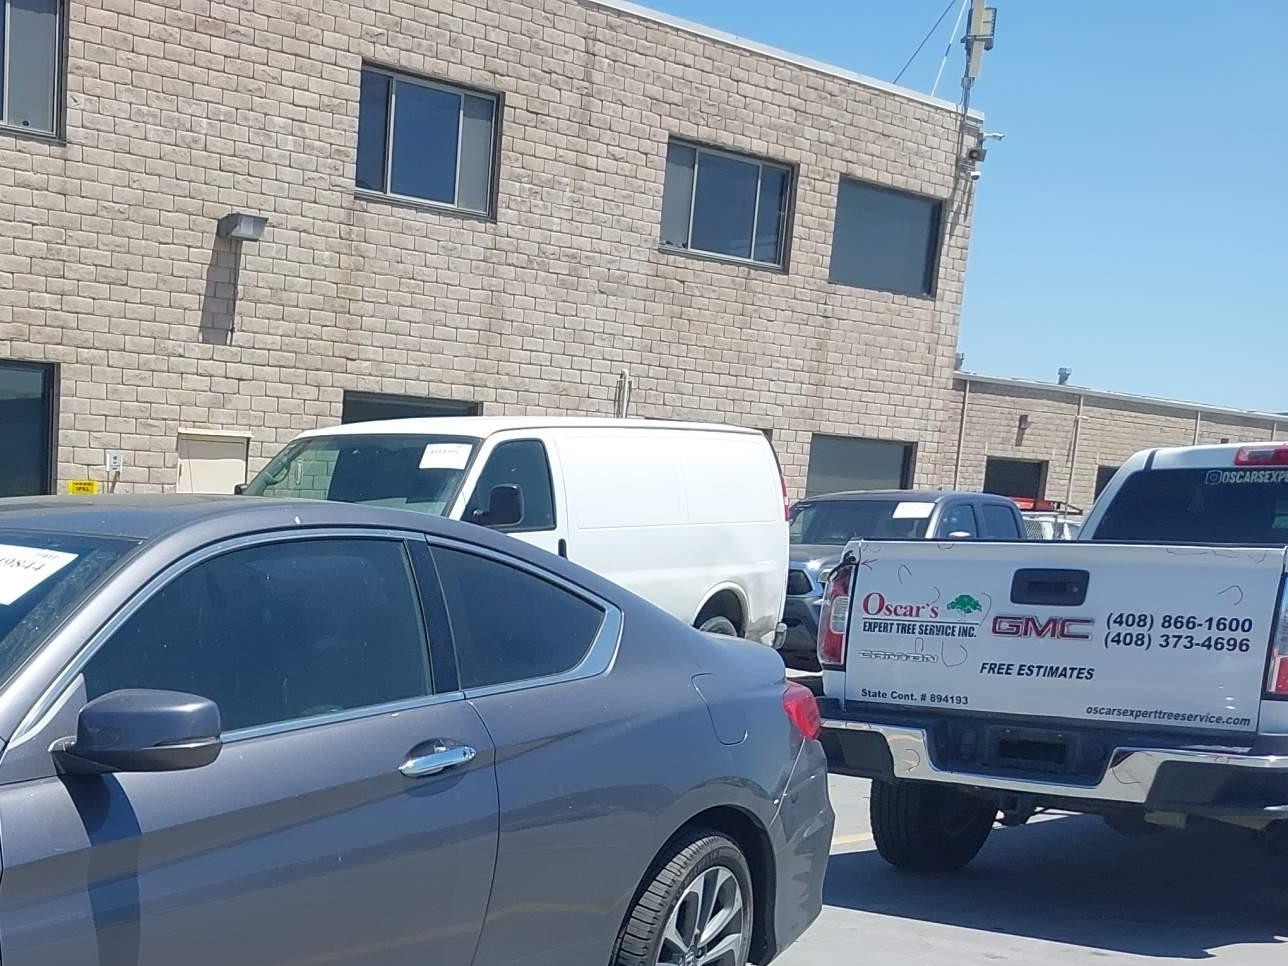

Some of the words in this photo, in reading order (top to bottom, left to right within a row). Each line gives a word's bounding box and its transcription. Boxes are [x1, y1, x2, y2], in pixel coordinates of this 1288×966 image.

[862, 592, 940, 619] Oscar's
[863, 621, 894, 633] EXPERT
[896, 623, 918, 635] TREE
[919, 624, 957, 637] SERVICE
[958, 626, 977, 638] INC.
[992, 615, 1095, 640] GMC
[1105, 612, 1154, 631] (408)
[1161, 614, 1253, 633] 866-1600
[1104, 631, 1152, 651] (408)
[1159, 634, 1251, 652] 373-4696
[979, 662, 1014, 675] FREE
[1017, 664, 1095, 680] ESTIMATES
[861, 688, 887, 699] State
[890, 691, 917, 702] Cont.
[920, 693, 927, 702] #
[930, 694, 969, 705] 894193
[1086, 704, 1251, 726] oscarsexperttreeservice.com
